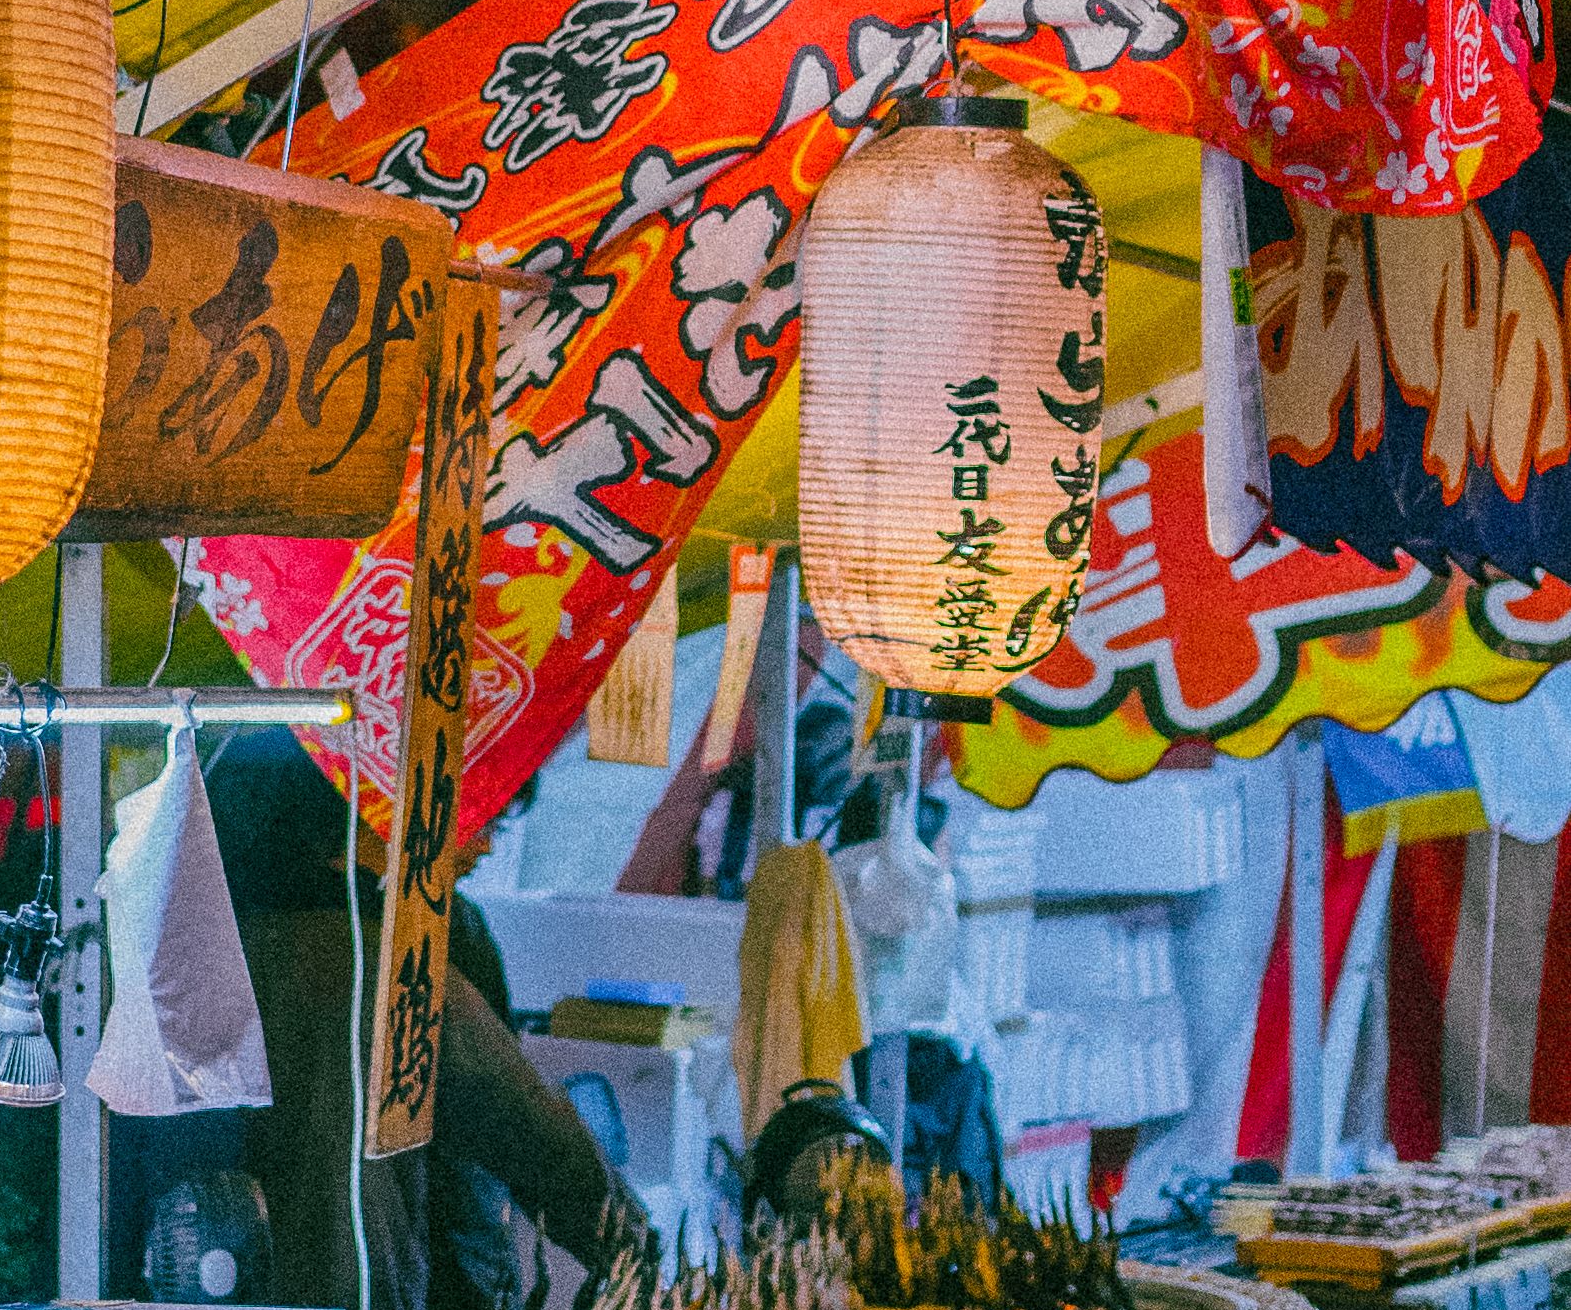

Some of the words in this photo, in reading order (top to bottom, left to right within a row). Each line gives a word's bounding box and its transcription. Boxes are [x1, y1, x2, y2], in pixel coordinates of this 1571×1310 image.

[931, 375, 1013, 673] 二代目友愛堂
